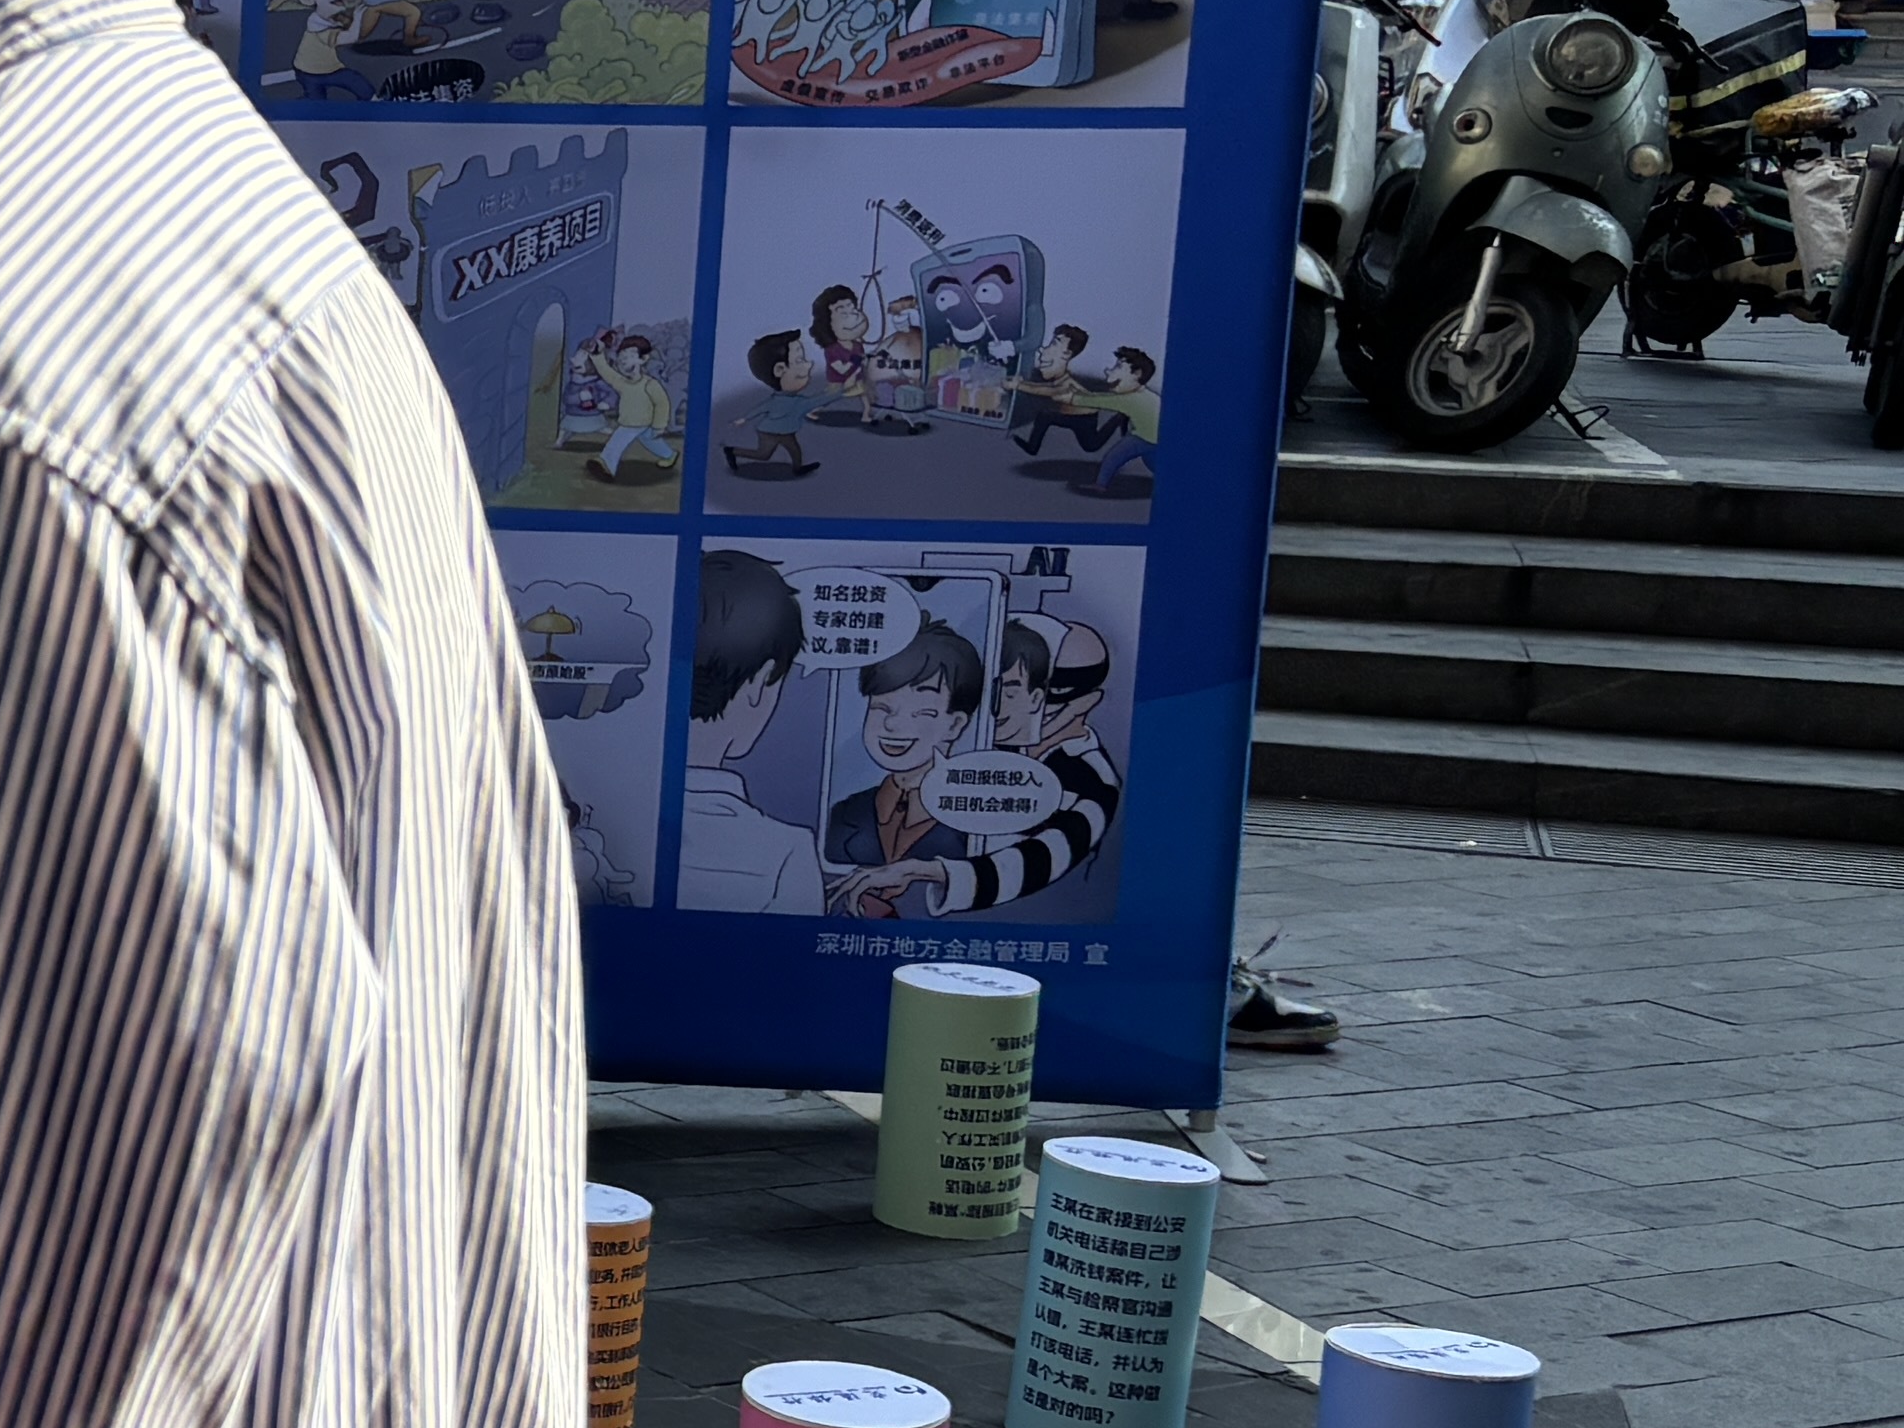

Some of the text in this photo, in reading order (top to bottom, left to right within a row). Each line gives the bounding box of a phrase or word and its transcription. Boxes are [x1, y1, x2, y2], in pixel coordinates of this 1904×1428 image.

[812, 583, 887, 604] 知名投资
[812, 609, 886, 631] 专家的建
[815, 932, 1070, 963] 深圳市地方金融管理局
[1051, 1192, 1187, 1234] 王某在家接到公安
[1047, 1221, 1182, 1262] 机关电话称自己涉
